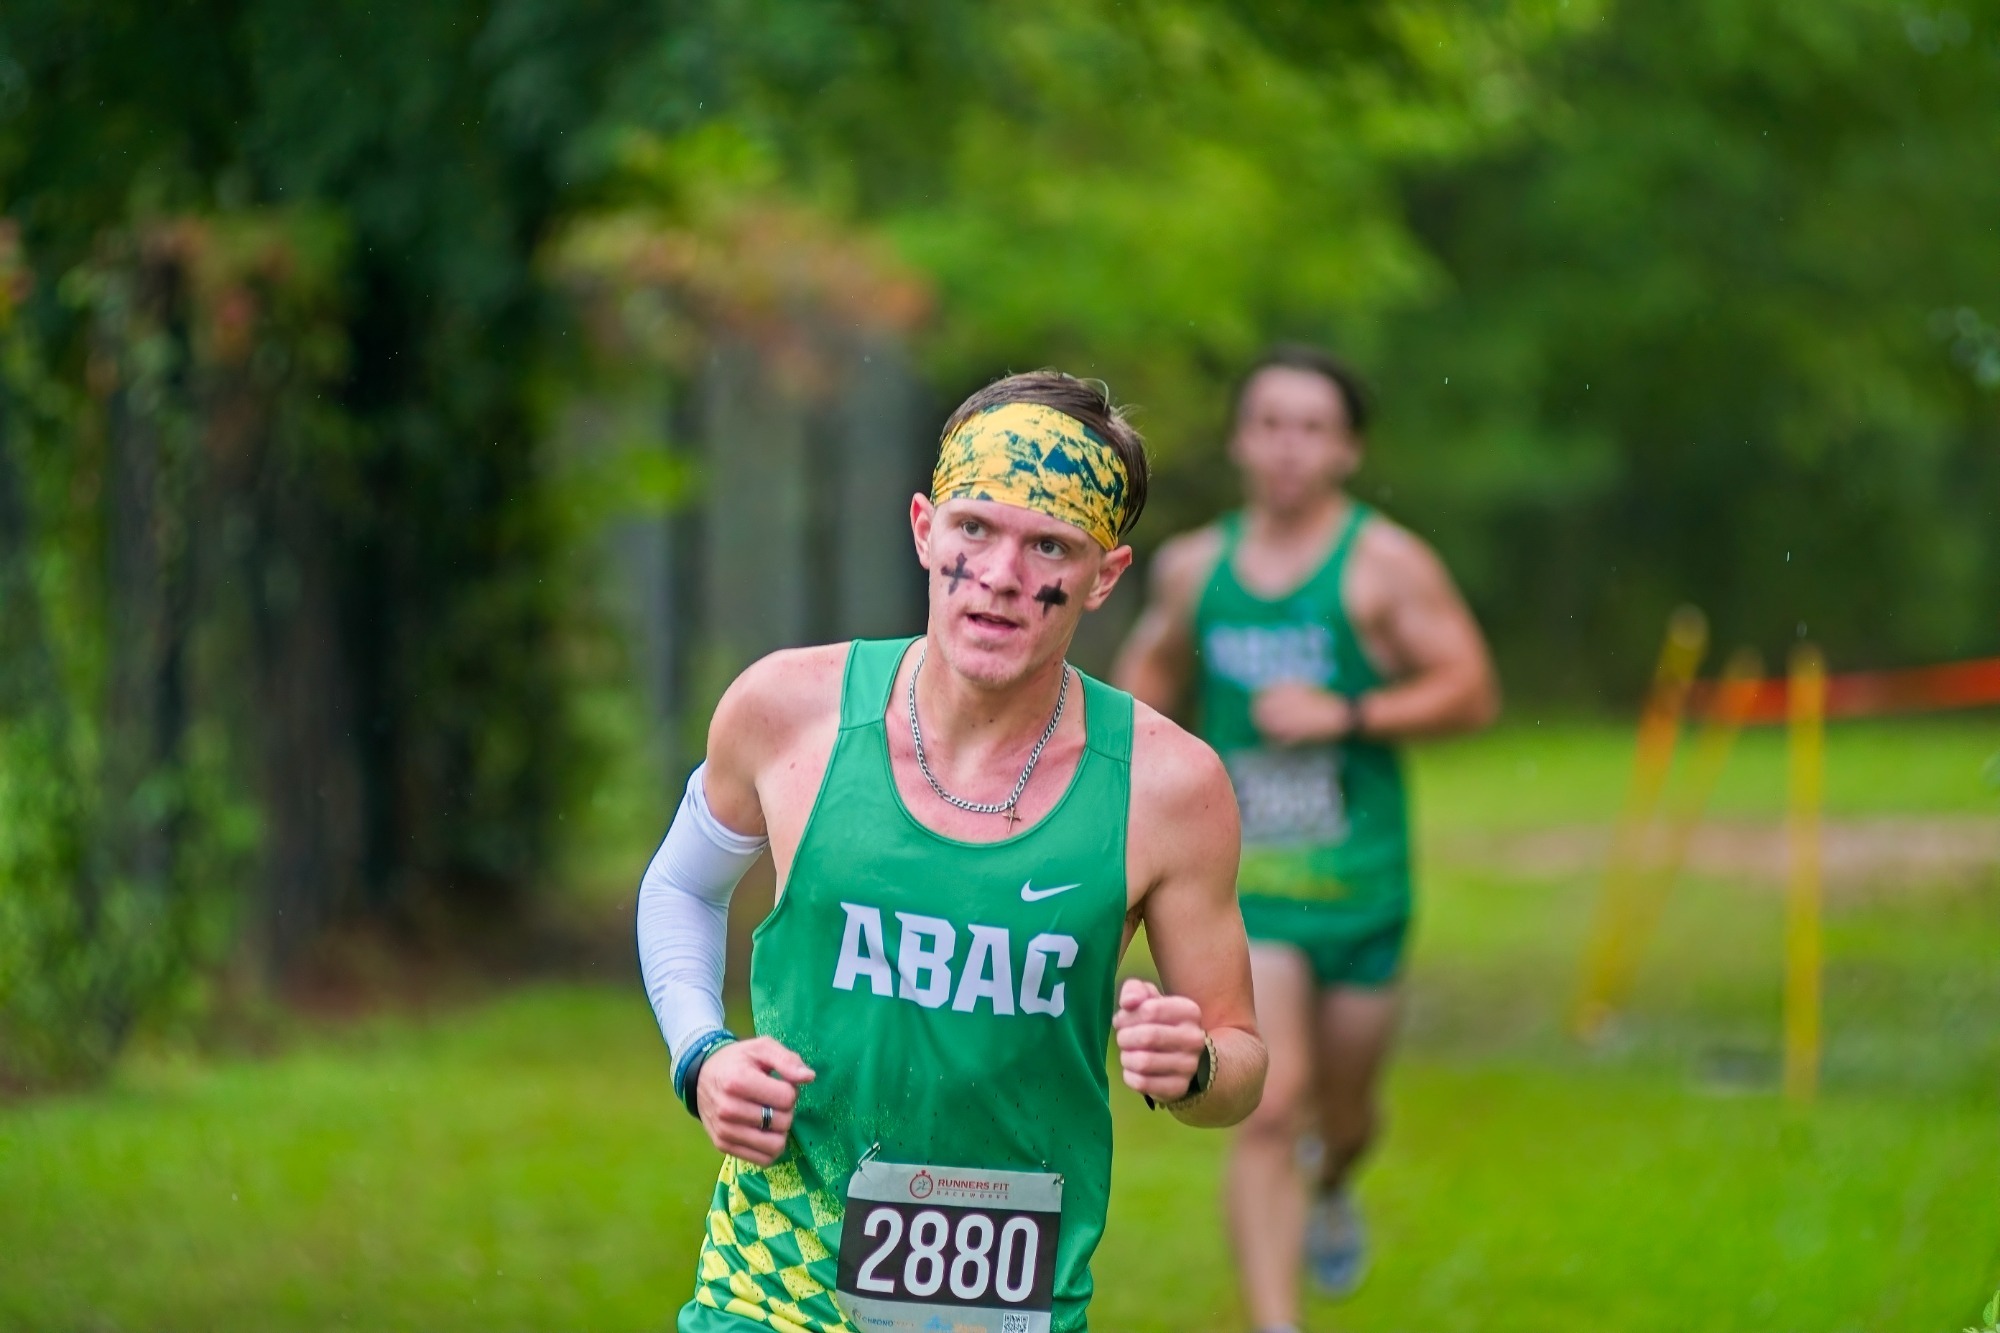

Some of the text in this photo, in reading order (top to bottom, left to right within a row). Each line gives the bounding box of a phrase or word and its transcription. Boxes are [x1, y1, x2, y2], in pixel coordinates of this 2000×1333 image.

[832, 901, 1079, 1018] ABAC
[938, 1179, 1009, 1191] RUNNERS FIT
[856, 1206, 1039, 1303] 2880
